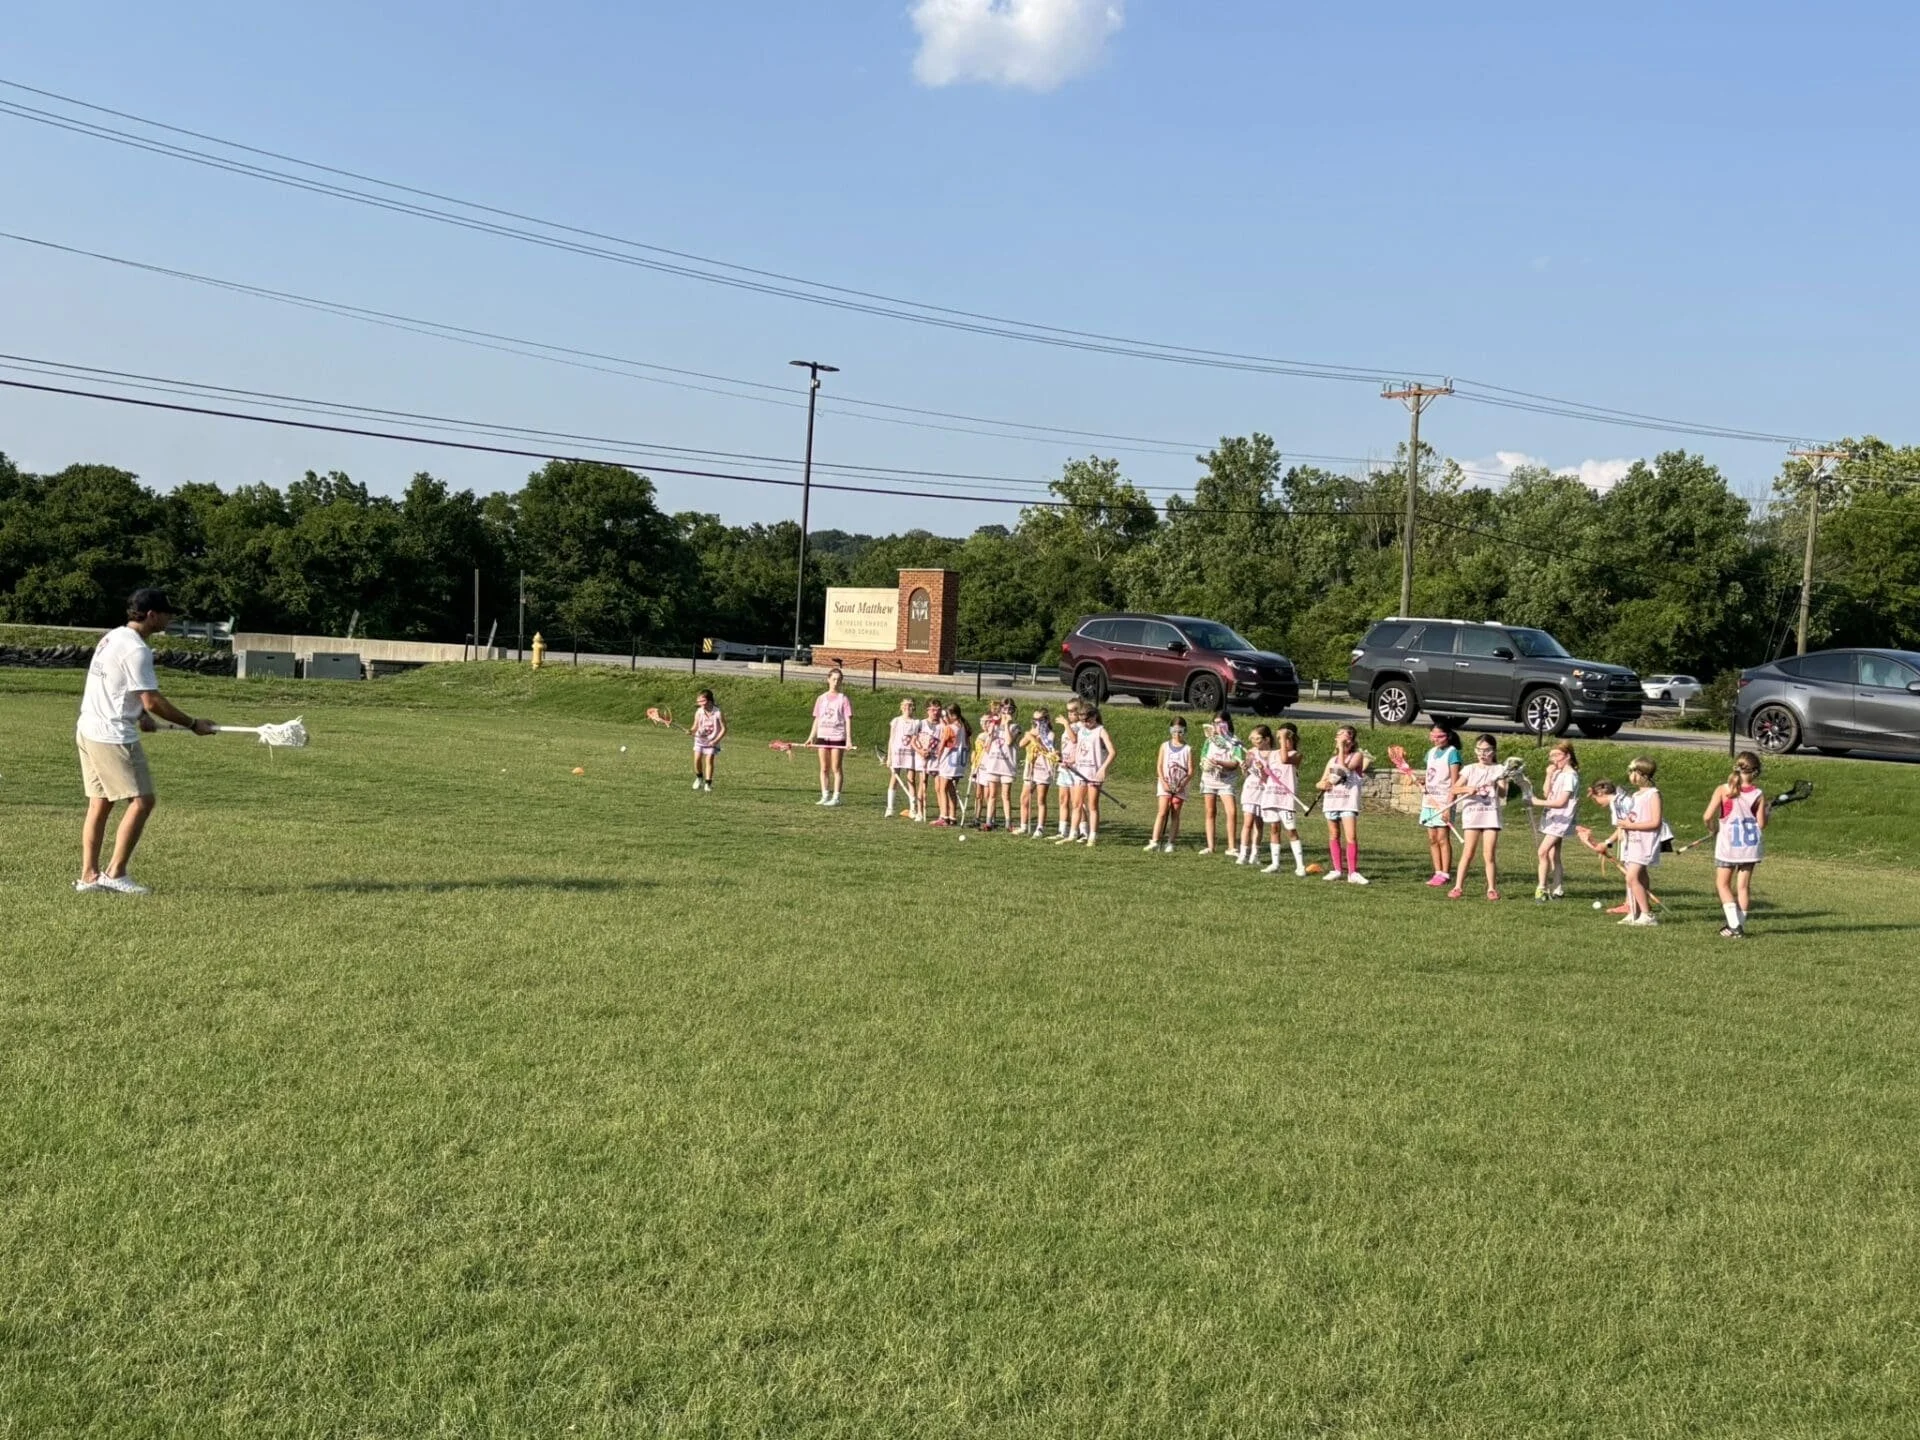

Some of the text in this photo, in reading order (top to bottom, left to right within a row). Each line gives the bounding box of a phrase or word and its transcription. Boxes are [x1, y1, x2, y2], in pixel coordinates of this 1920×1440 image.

[833, 601, 894, 614] Saint Matthew
[1729, 817, 1760, 848] 18
